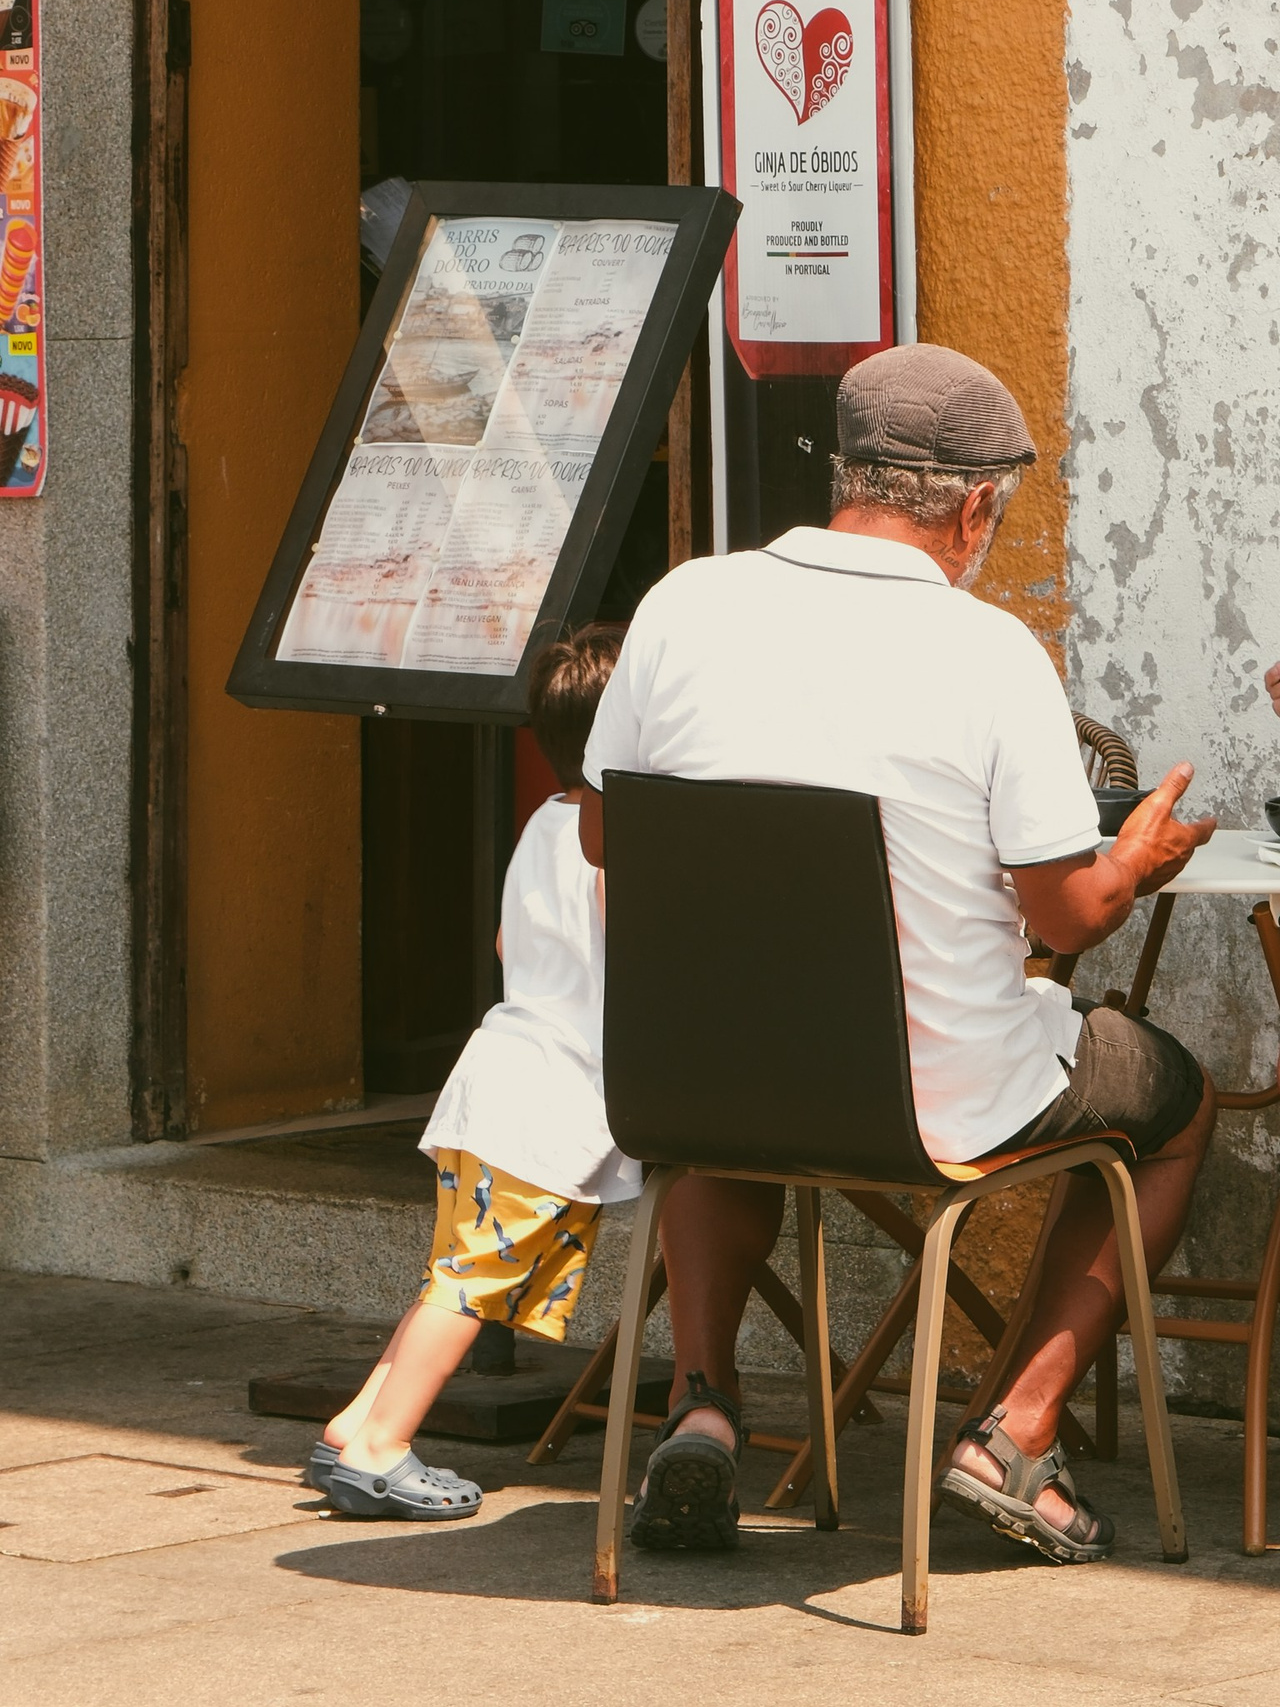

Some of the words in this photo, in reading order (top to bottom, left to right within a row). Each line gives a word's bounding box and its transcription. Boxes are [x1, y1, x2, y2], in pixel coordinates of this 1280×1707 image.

[10, 55, 30, 65] NOVO
[754, 151, 786, 178] GINJA
[790, 151, 807, 173] DE
[811, 145, 859, 174] ÓBIDOS
[761, 181, 779, 192] Sweet
[781, 181, 786, 192] &
[788, 181, 804, 192] Sour
[805, 181, 828, 193] Cherry
[829, 180, 853, 193] Liqueur
[10, 199, 31, 210] NOVO
[791, 221, 823, 232] PROUDLY
[444, 229, 500, 245] BARRIS
[766, 235, 801, 246] PRODUCED
[804, 235, 818, 246] AND
[820, 235, 849, 246] BOTTLED
[558, 232, 612, 256] BARRIS
[611, 233, 631, 254] DO
[454, 244, 477, 258] DO
[433, 258, 491, 274] DOURO
[592, 258, 626, 267] COUVERT
[785, 264, 793, 275] IN
[794, 264, 831, 275] PORTUGAL
[463, 280, 497, 291] PRATO
[498, 280, 515, 291] DO
[515, 281, 534, 292] DIA
[574, 297, 611, 306] ENTRADAS
[12, 340, 33, 350] NOVO
[553, 356, 584, 365] SALADAS
[543, 399, 569, 408] SOPAS
[350, 455, 402, 477] BARRIS
[403, 457, 423, 476] DO
[471, 457, 529, 481] BARRIS
[386, 481, 411, 490] PEIXES
[511, 485, 538, 494] CARNES
[450, 577, 474, 587] MENU
[476, 578, 494, 588] PARA
[455, 614, 477, 623] MENU
[478, 614, 502, 624] VEGAN
